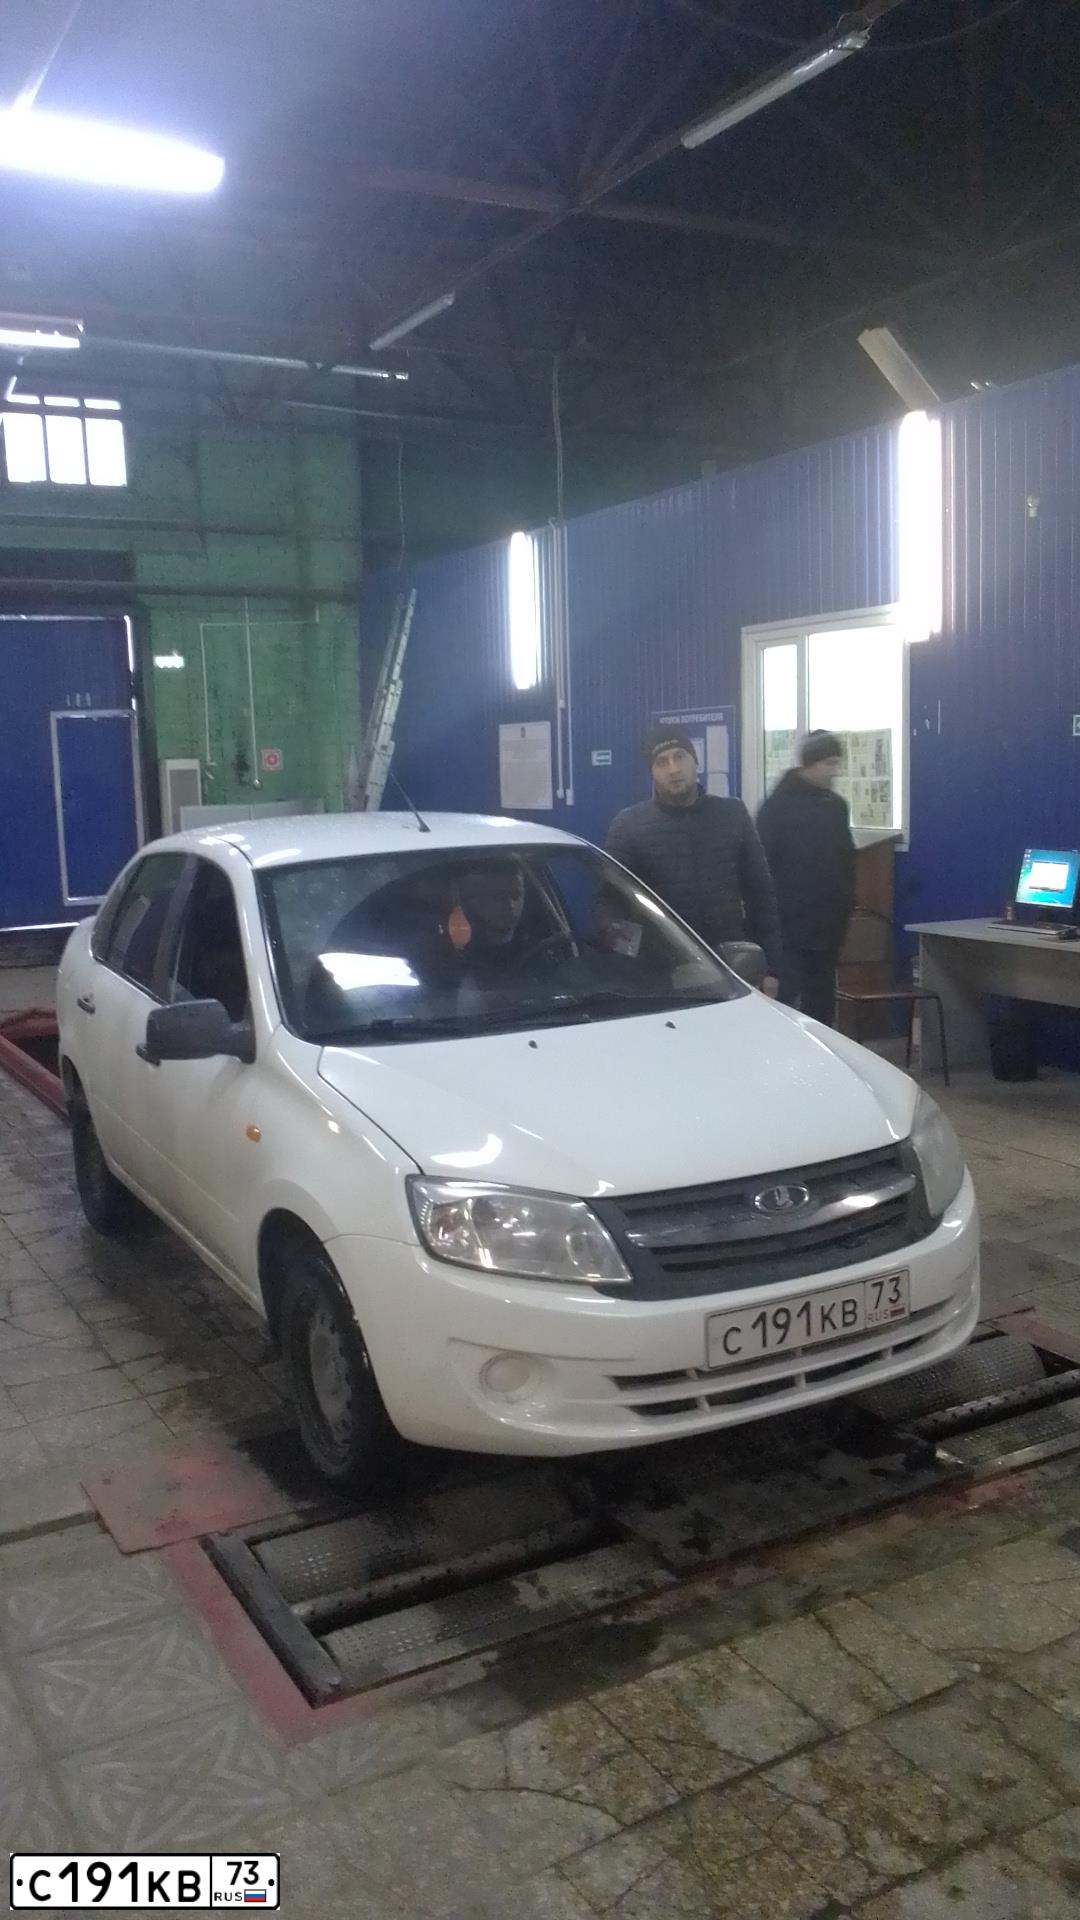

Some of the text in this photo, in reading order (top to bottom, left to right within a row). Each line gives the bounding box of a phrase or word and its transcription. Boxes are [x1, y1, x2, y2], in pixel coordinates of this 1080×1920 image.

[722, 1276, 901, 1355] С191КВ 73
[867, 1309, 889, 1323] RUS
